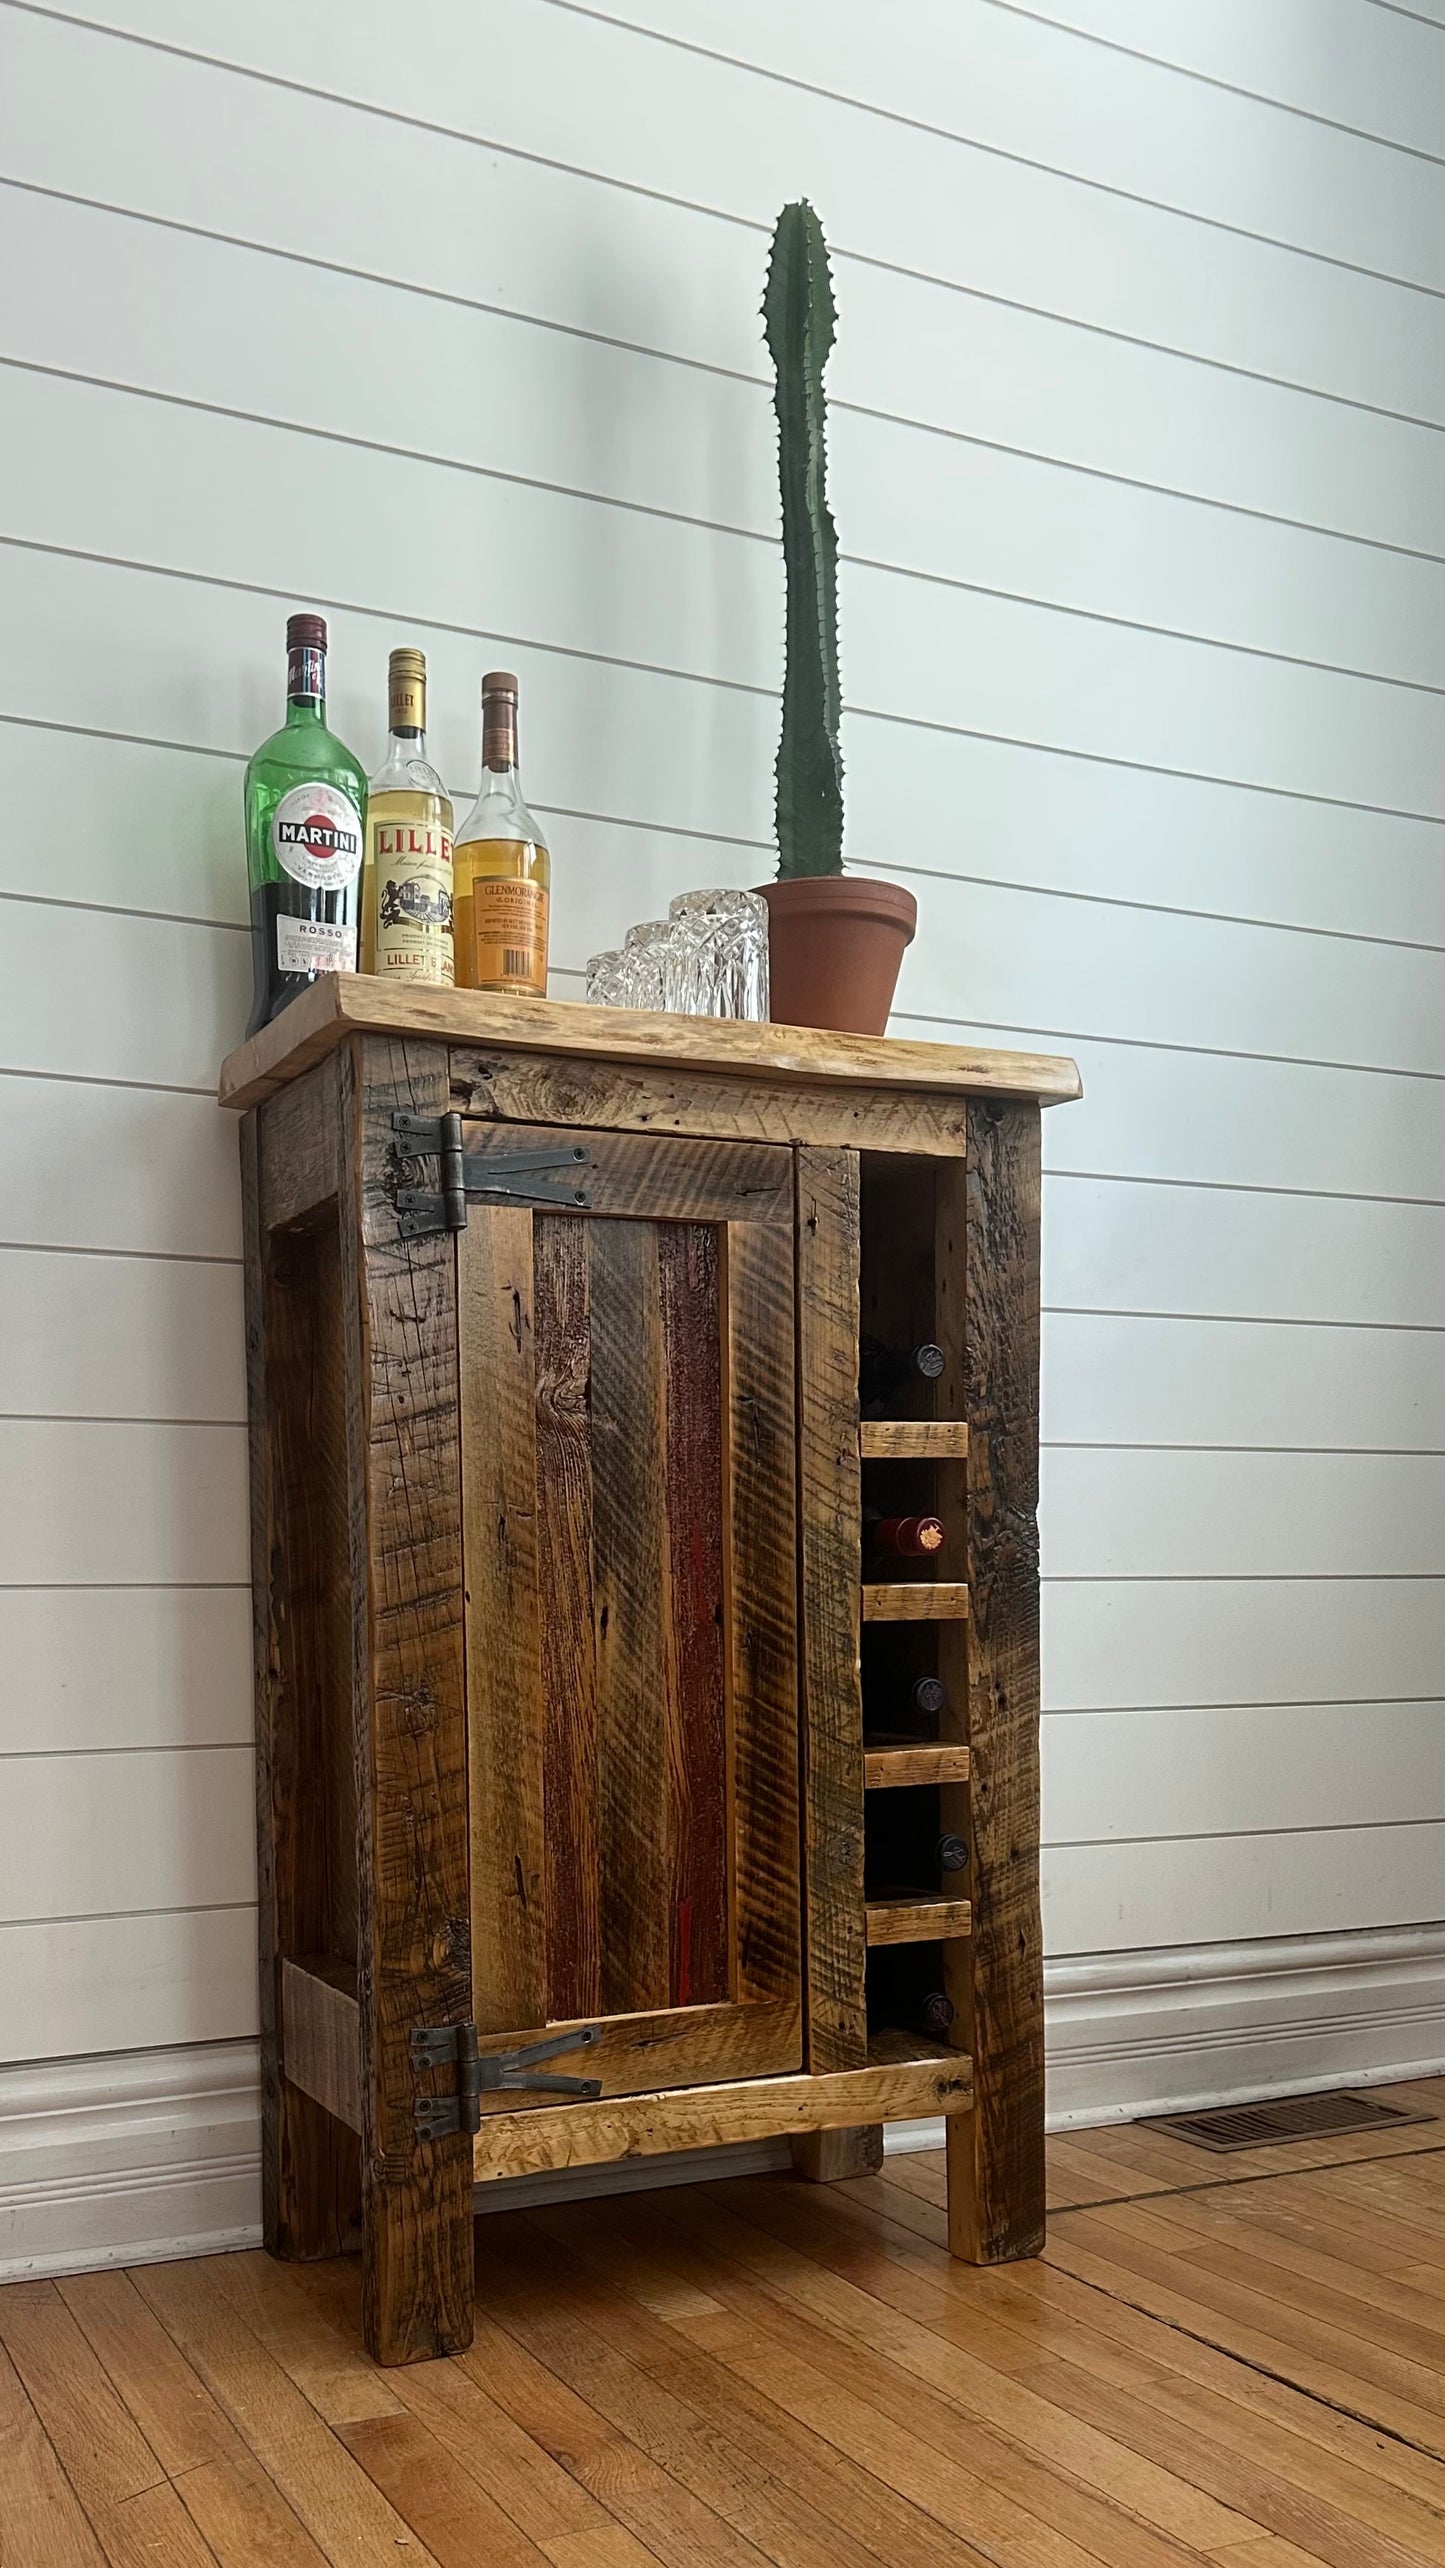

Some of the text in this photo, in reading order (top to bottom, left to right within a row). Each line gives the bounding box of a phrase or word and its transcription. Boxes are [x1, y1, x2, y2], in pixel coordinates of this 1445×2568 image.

[282, 825, 356, 851] MARTINI
[299, 924, 343, 939] ROSSO
[387, 953, 427, 966] LILLET
